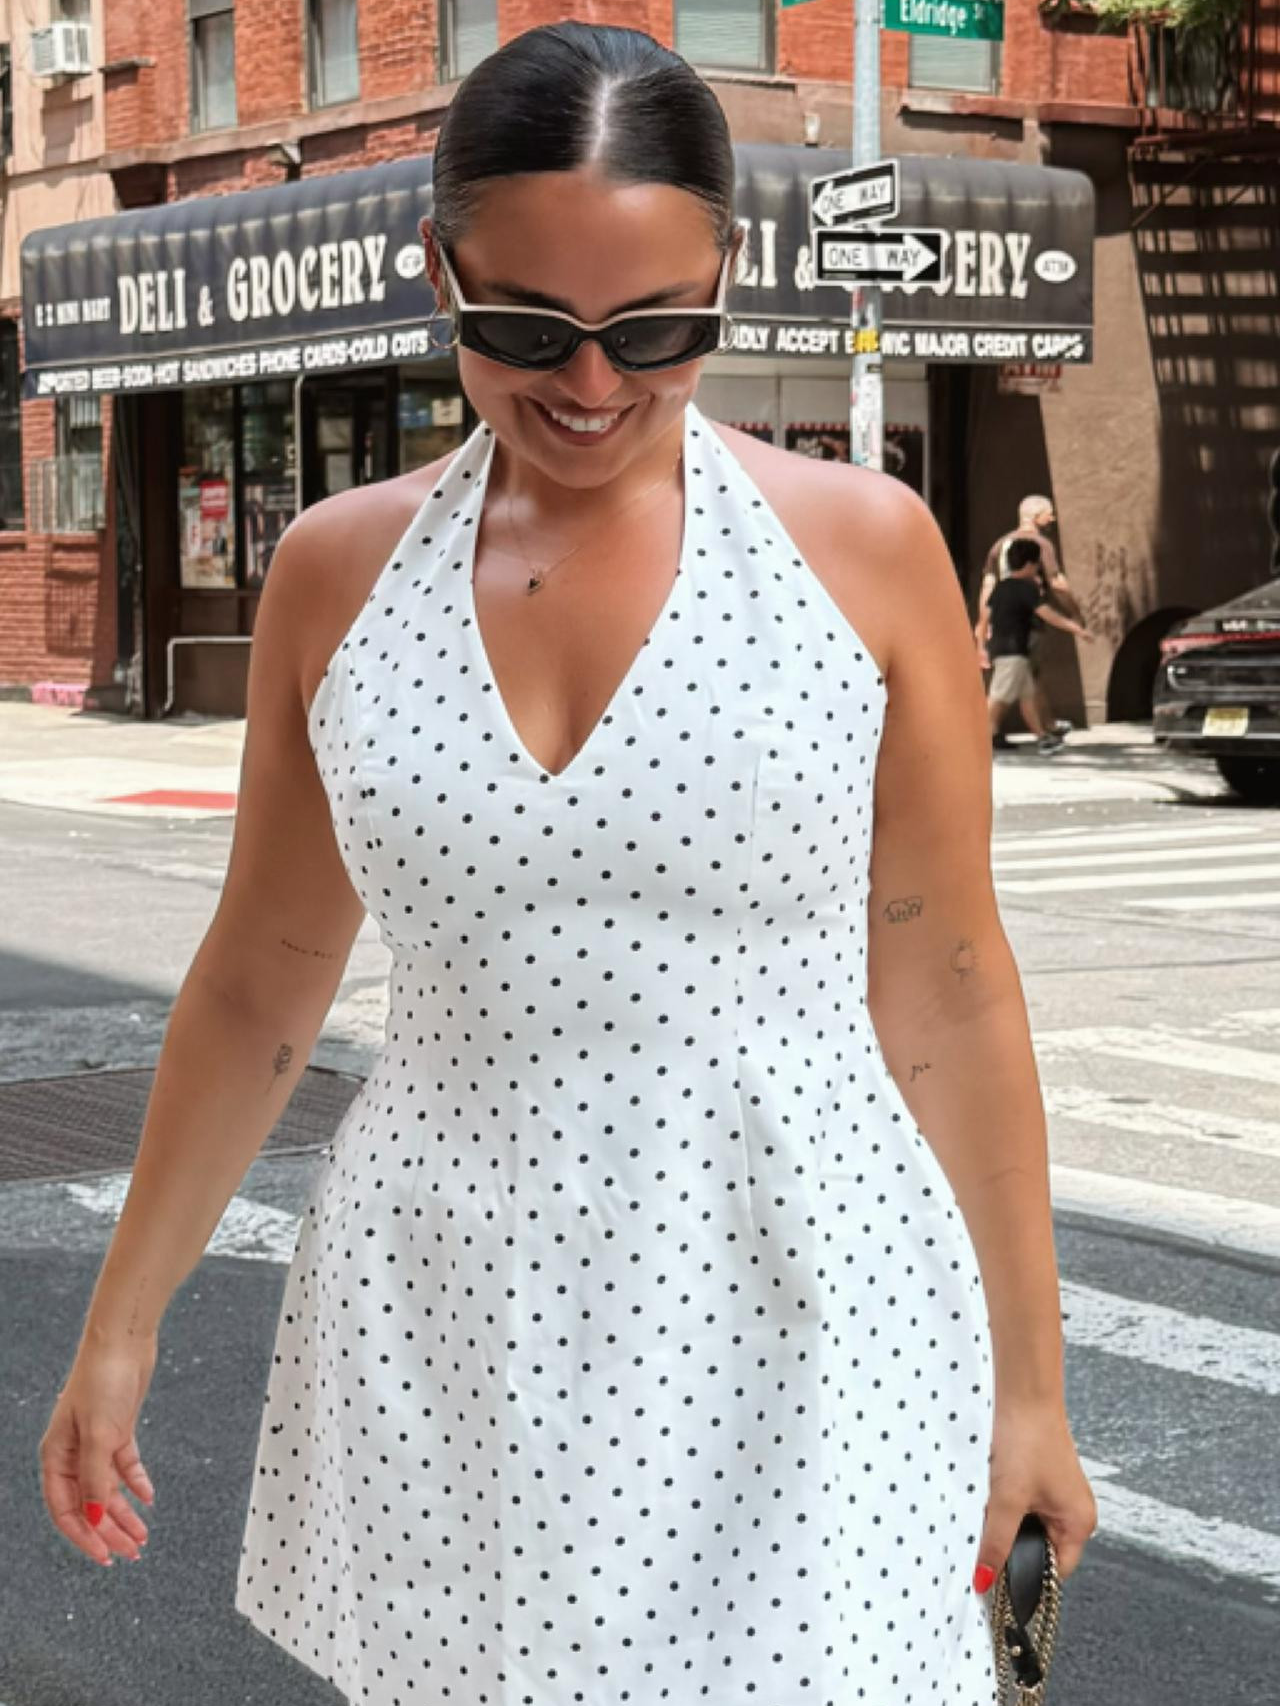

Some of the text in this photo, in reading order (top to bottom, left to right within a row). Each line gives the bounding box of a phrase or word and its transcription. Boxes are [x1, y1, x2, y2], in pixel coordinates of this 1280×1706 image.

[822, 181, 888, 212] ONE WAY
[829, 247, 921, 267] ONE WAY
[117, 233, 387, 334] DELI & GROCERY
[182, 351, 257, 382] SANDWICHES
[260, 347, 301, 373] PHONE
[392, 330, 429, 356] CUTS
[776, 327, 841, 352] ACCEPT
[914, 332, 969, 356] MAJOR
[973, 333, 1028, 358] CREDIT
